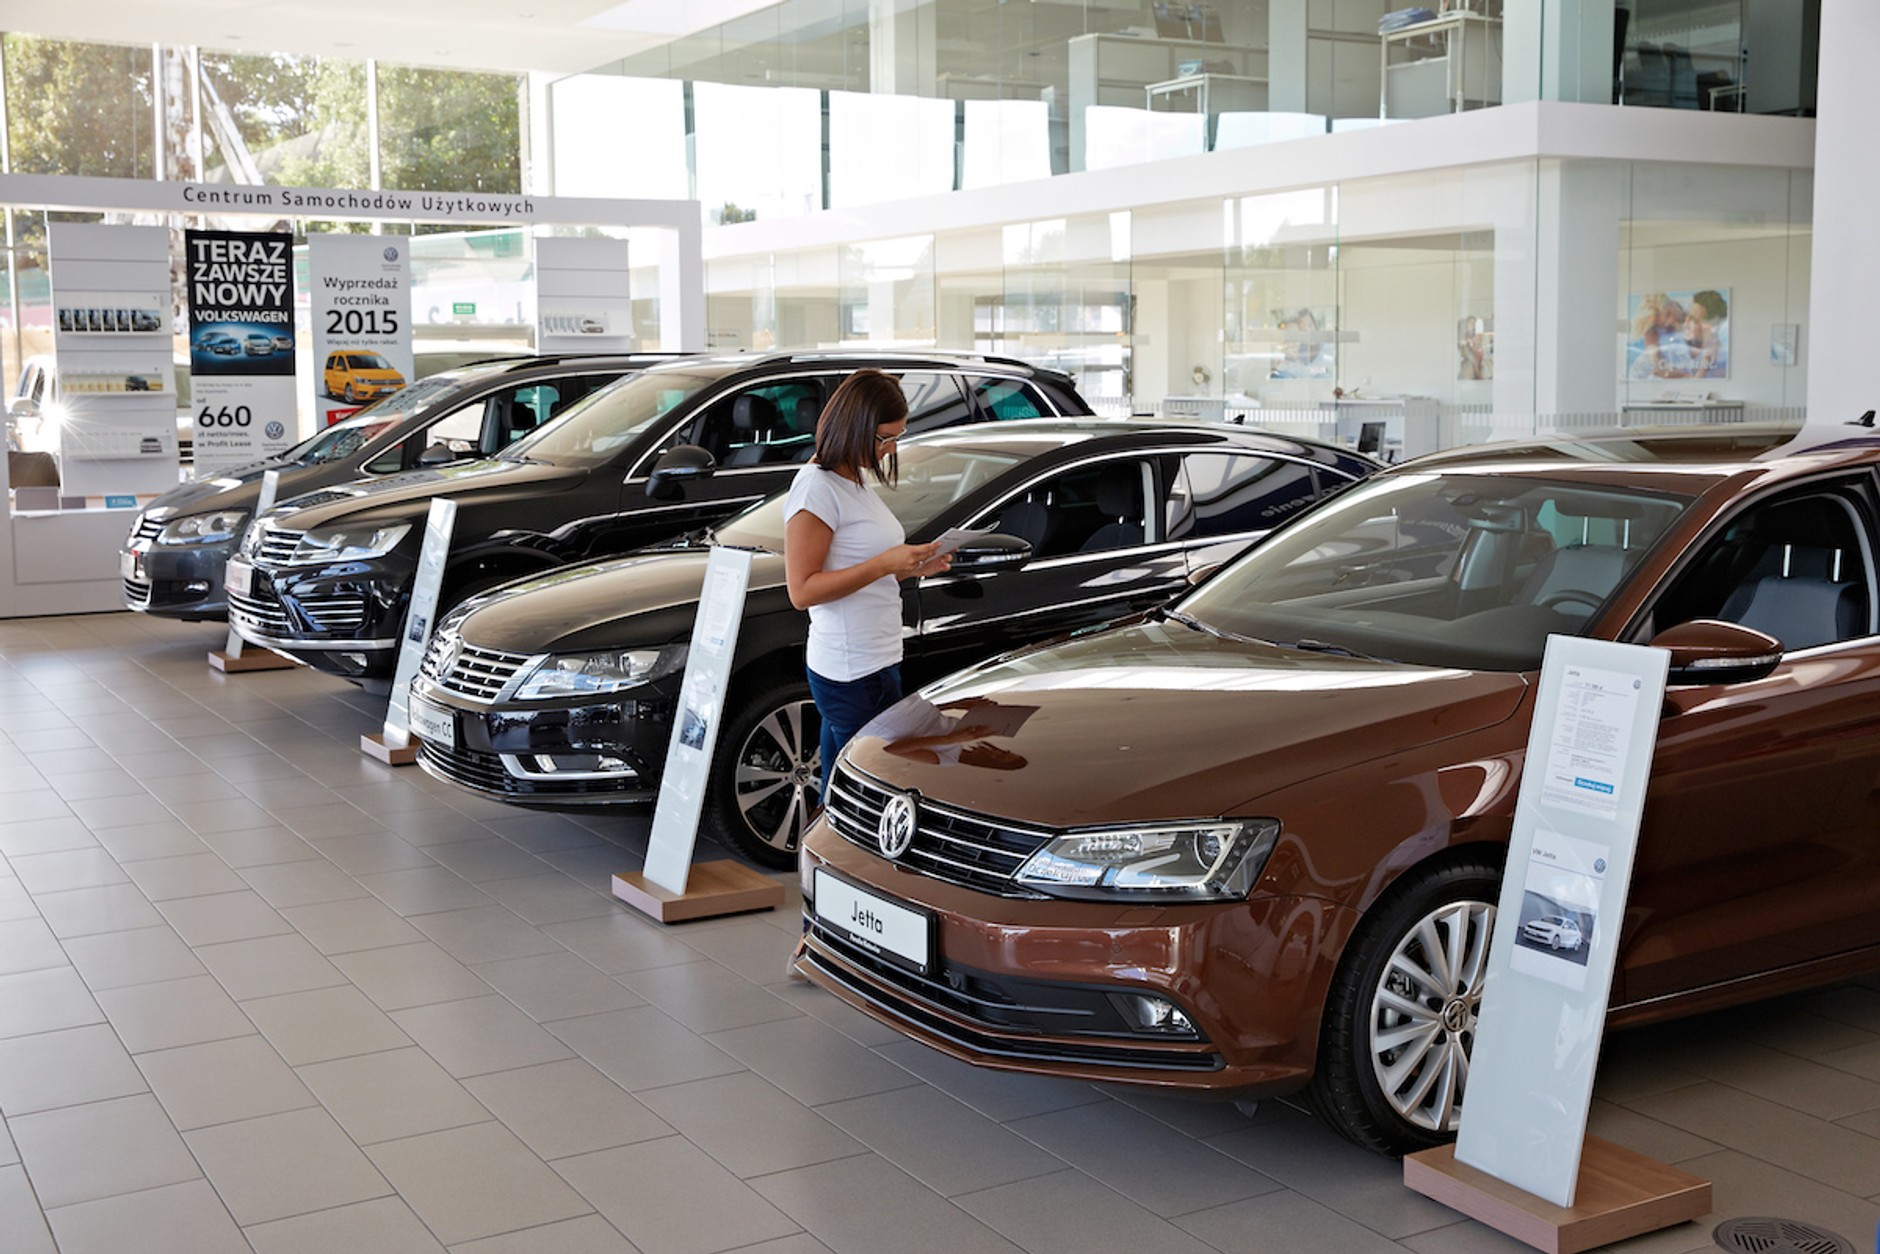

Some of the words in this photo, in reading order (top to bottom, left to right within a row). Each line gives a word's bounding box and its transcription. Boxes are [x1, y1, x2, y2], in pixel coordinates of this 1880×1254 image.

[183, 186, 272, 205] Centrum
[282, 190, 412, 210] Samochodów
[422, 196, 534, 216] Użytkowych
[192, 239, 286, 264] TERAZ
[193, 263, 287, 283] ZAWSZE
[323, 276, 398, 291] Wyprzedaż
[195, 283, 287, 306] NOWY
[333, 294, 390, 306] rocznika
[195, 310, 288, 323] VOLKSWAGEN
[326, 309, 398, 335] 2015
[198, 405, 252, 428] 660
[441, 720, 452, 739] CC
[1542, 849, 1557, 860] Jetta
[850, 900, 884, 935] Jetta
